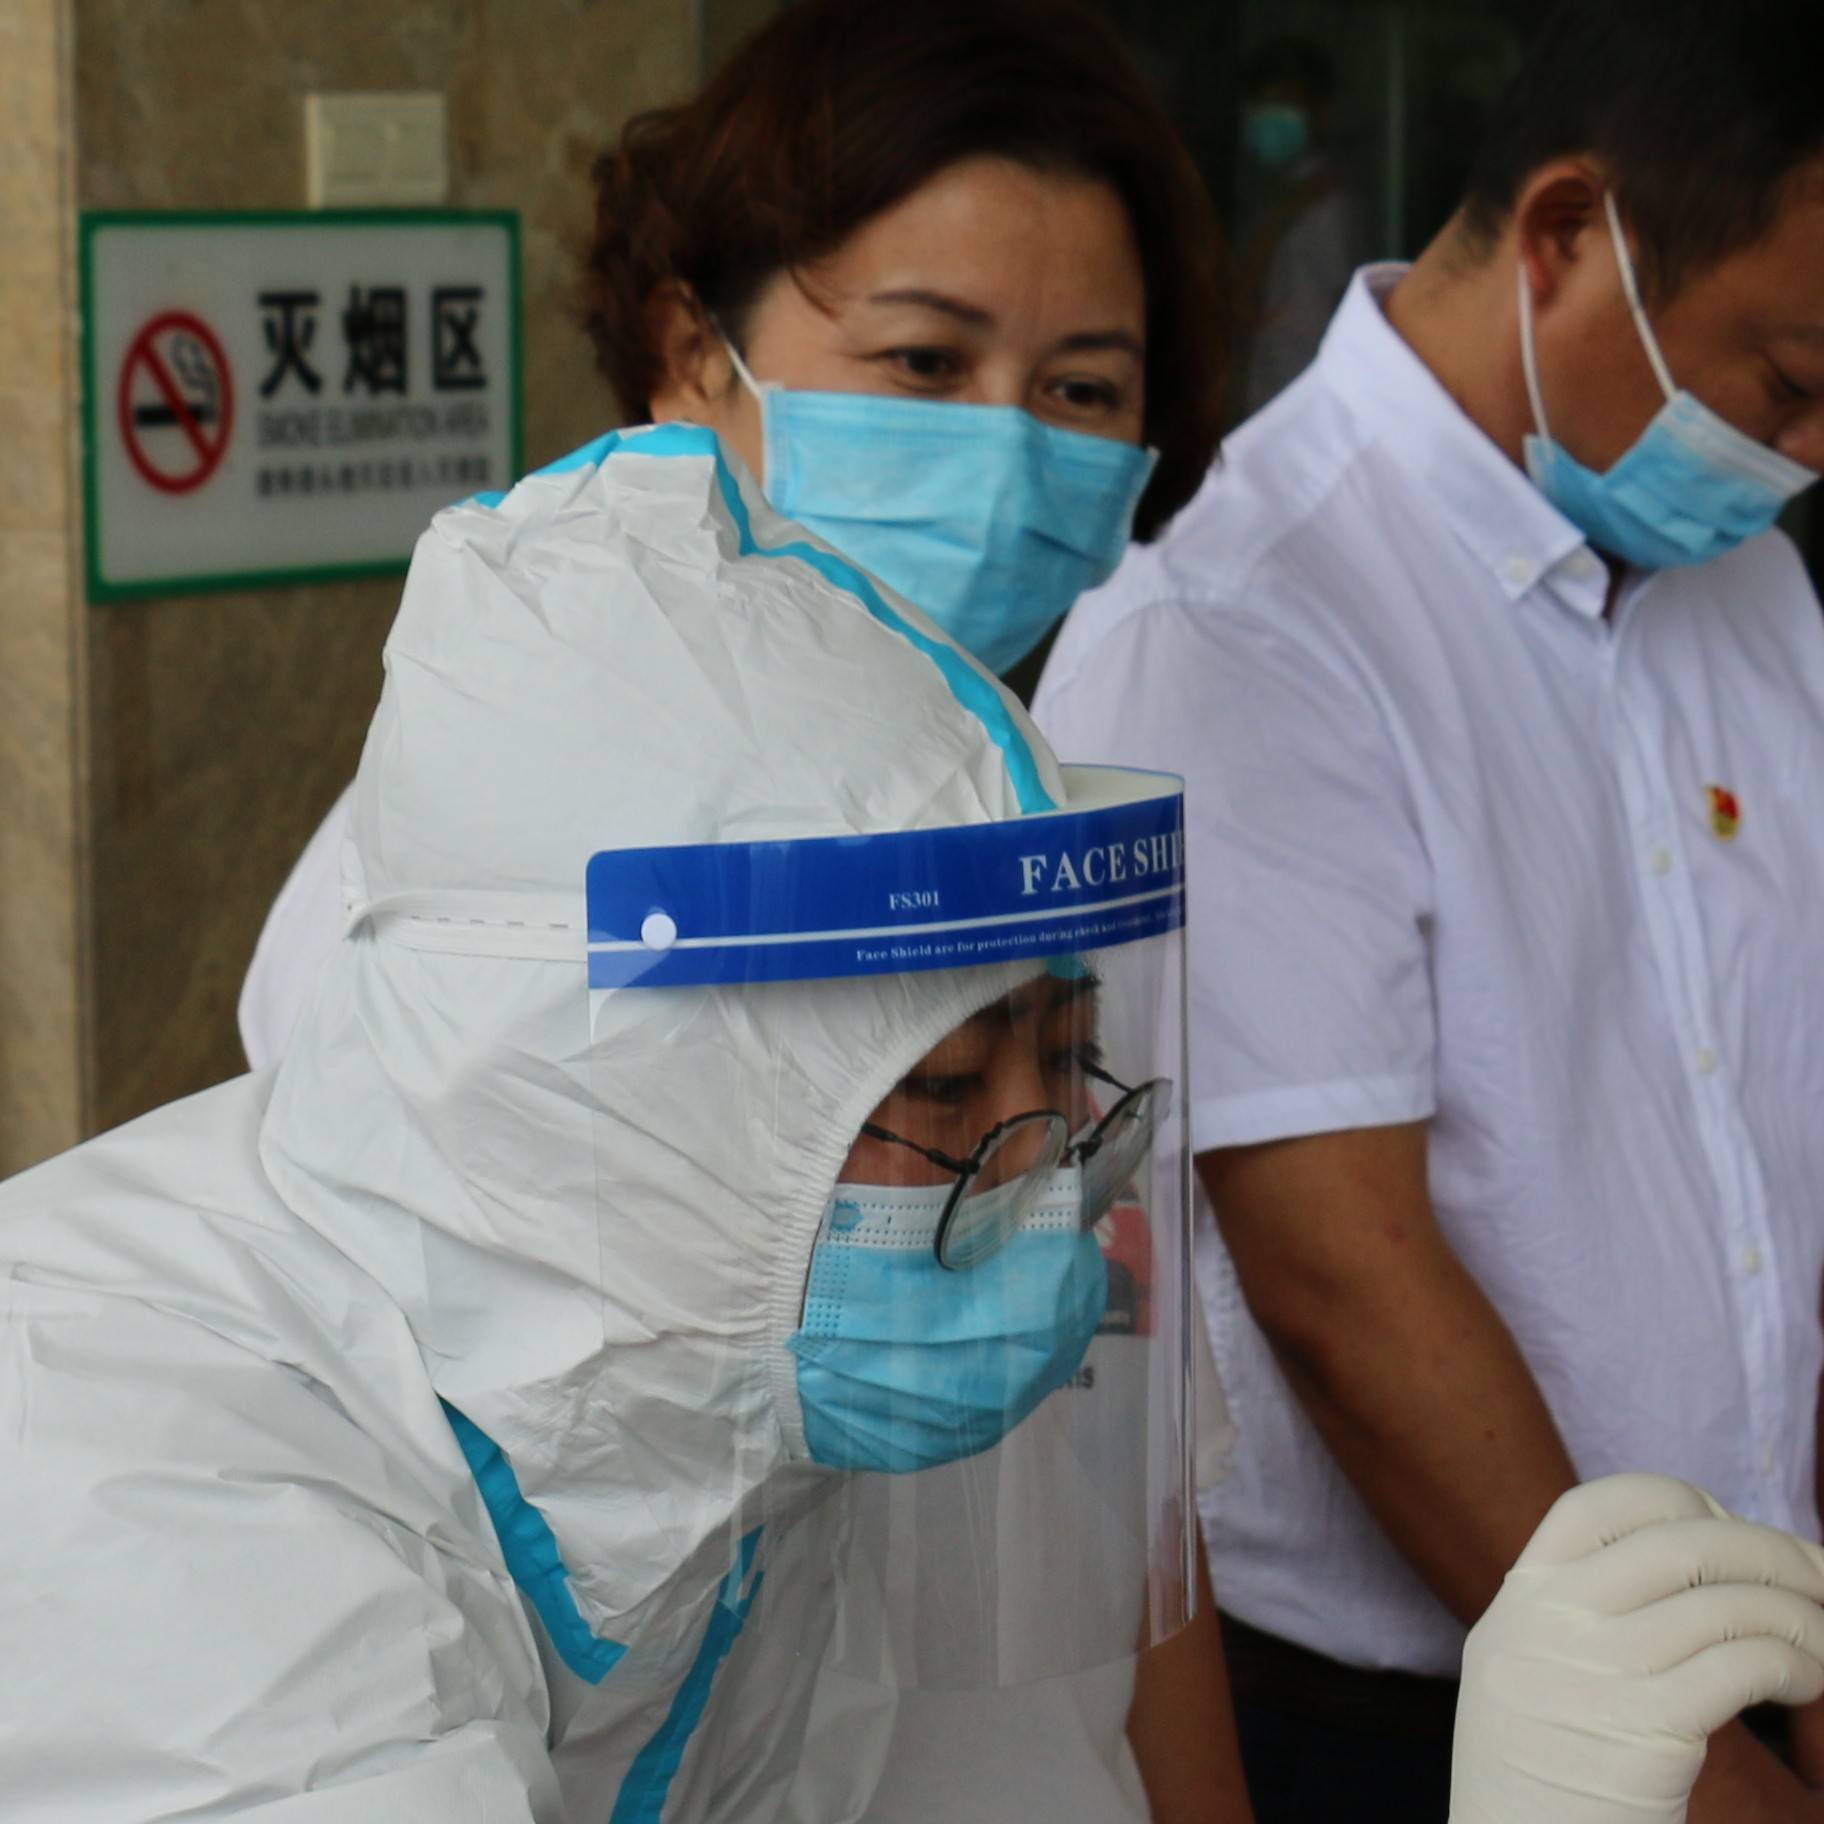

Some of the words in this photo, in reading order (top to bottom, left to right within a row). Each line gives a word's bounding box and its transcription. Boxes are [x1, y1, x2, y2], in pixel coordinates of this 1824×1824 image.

[257, 285, 486, 397] 灭烟区
[1018, 843, 1127, 895] FACE
[888, 890, 940, 911] FS301
[856, 949, 888, 962] Face
[890, 945, 932, 959] Shield
[934, 945, 954, 954] are
[957, 942, 975, 953] for
[977, 933, 1037, 952] protection
